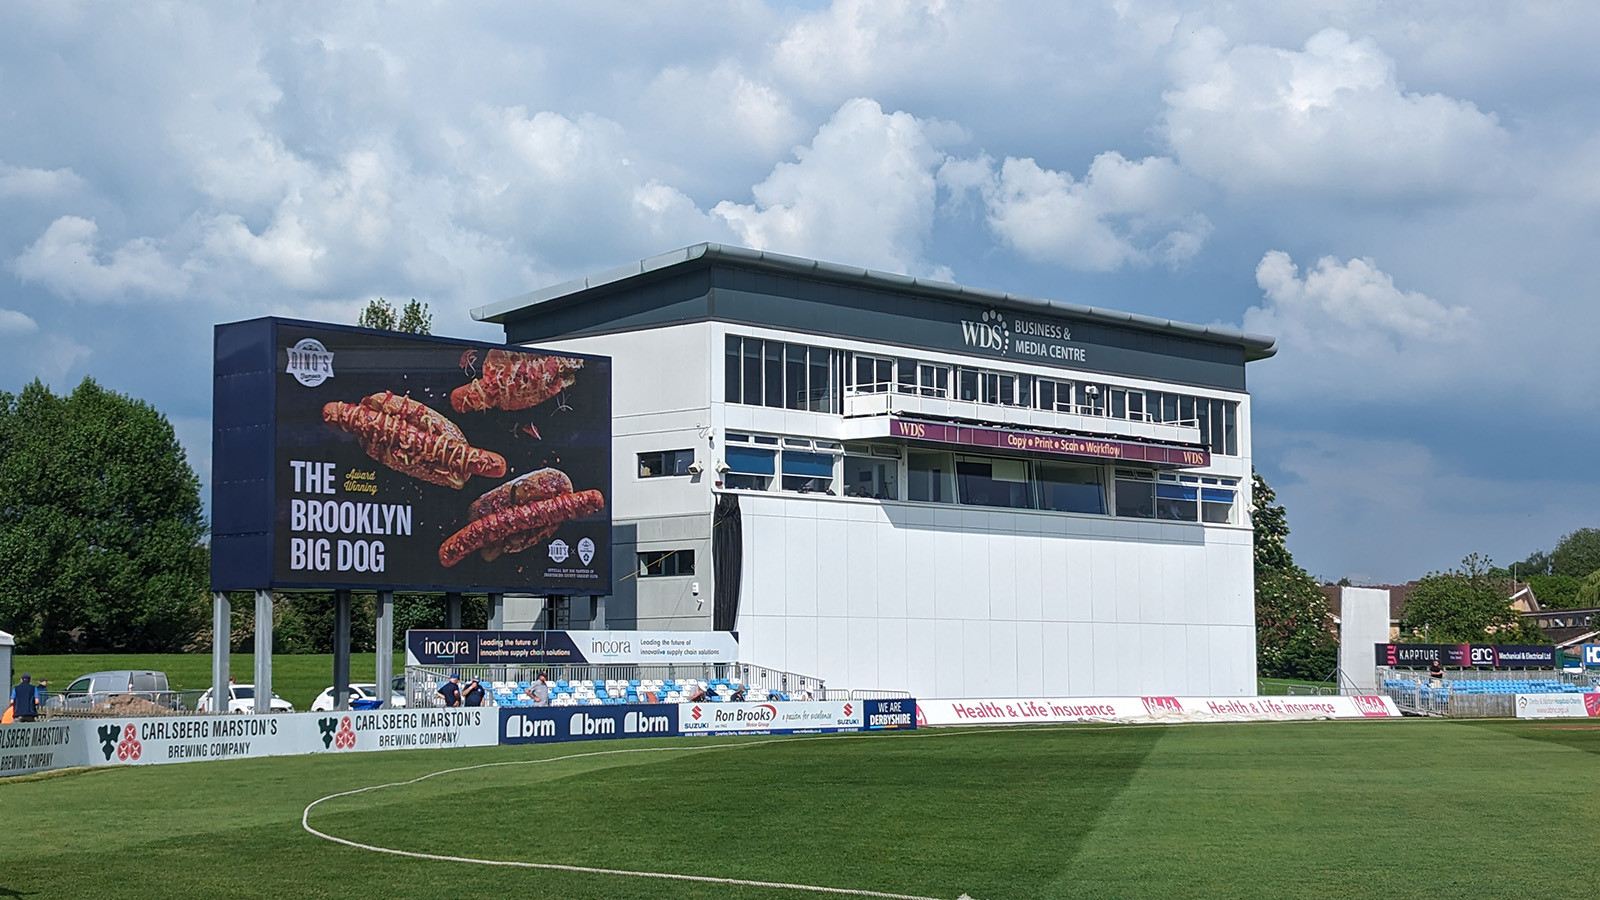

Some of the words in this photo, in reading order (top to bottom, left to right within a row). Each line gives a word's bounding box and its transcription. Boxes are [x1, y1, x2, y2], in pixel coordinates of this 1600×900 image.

[961, 320, 1002, 350] WDS
[1014, 320, 1062, 339] BUSINESS
[1063, 327, 1071, 341] &
[1015, 340, 1048, 356] MEDIA
[1049, 344, 1086, 362] CENTRE
[292, 352, 329, 373] DINO'S
[899, 422, 925, 438] WDS
[1008, 434, 1027, 449] Copy
[1034, 437, 1053, 449] Print
[1060, 439, 1079, 451] Scan
[1085, 442, 1120, 456] Workflow
[1183, 451, 1203, 464] WDS
[290, 460, 336, 494] THE
[345, 468, 376, 480] Award
[343, 480, 378, 495] Winning
[291, 499, 412, 536] BROOKLYN
[290, 538, 331, 571] BIG
[337, 540, 385, 572] DOG
[425, 637, 469, 655] incora
[480, 639, 503, 647] Leading
[592, 638, 631, 653] incora
[641, 639, 660, 647] Leading
[1399, 650, 1439, 660] KAPPTURE
[1471, 648, 1493, 661] arc
[1526, 652, 1544, 660] Electrical
[715, 709, 735, 721] Ron
[737, 708, 770, 721] Brooks
[878, 703, 888, 713] WE
[889, 702, 901, 712] ARE
[952, 702, 1005, 719] Health
[1006, 704, 1018, 718] &
[1017, 701, 1047, 718] Life
[1048, 702, 1116, 717] insurance
[1206, 700, 1249, 714] Health
[1249, 703, 1259, 714] &
[1257, 699, 1281, 714] Life
[1281, 700, 1336, 714] insurance
[356, 713, 417, 731] CARLSBERG
[421, 711, 481, 728] MARSTON'S
[522, 715, 555, 737] brm
[584, 713, 615, 735] brm
[638, 712, 669, 733] brm
[870, 713, 911, 725] DERBYSHIRE
[31, 725, 70, 746] MARSTON'S
[141, 721, 209, 740] CARLSBERG
[212, 718, 278, 738] MARSTON'S
[379, 733, 417, 747] BREWING
[420, 732, 457, 745] COMPANY
[168, 744, 207, 758] BREWING
[210, 742, 251, 756] COMPANY
[0, 754, 27, 771] BREWING
[28, 752, 54, 769] COMPANY
